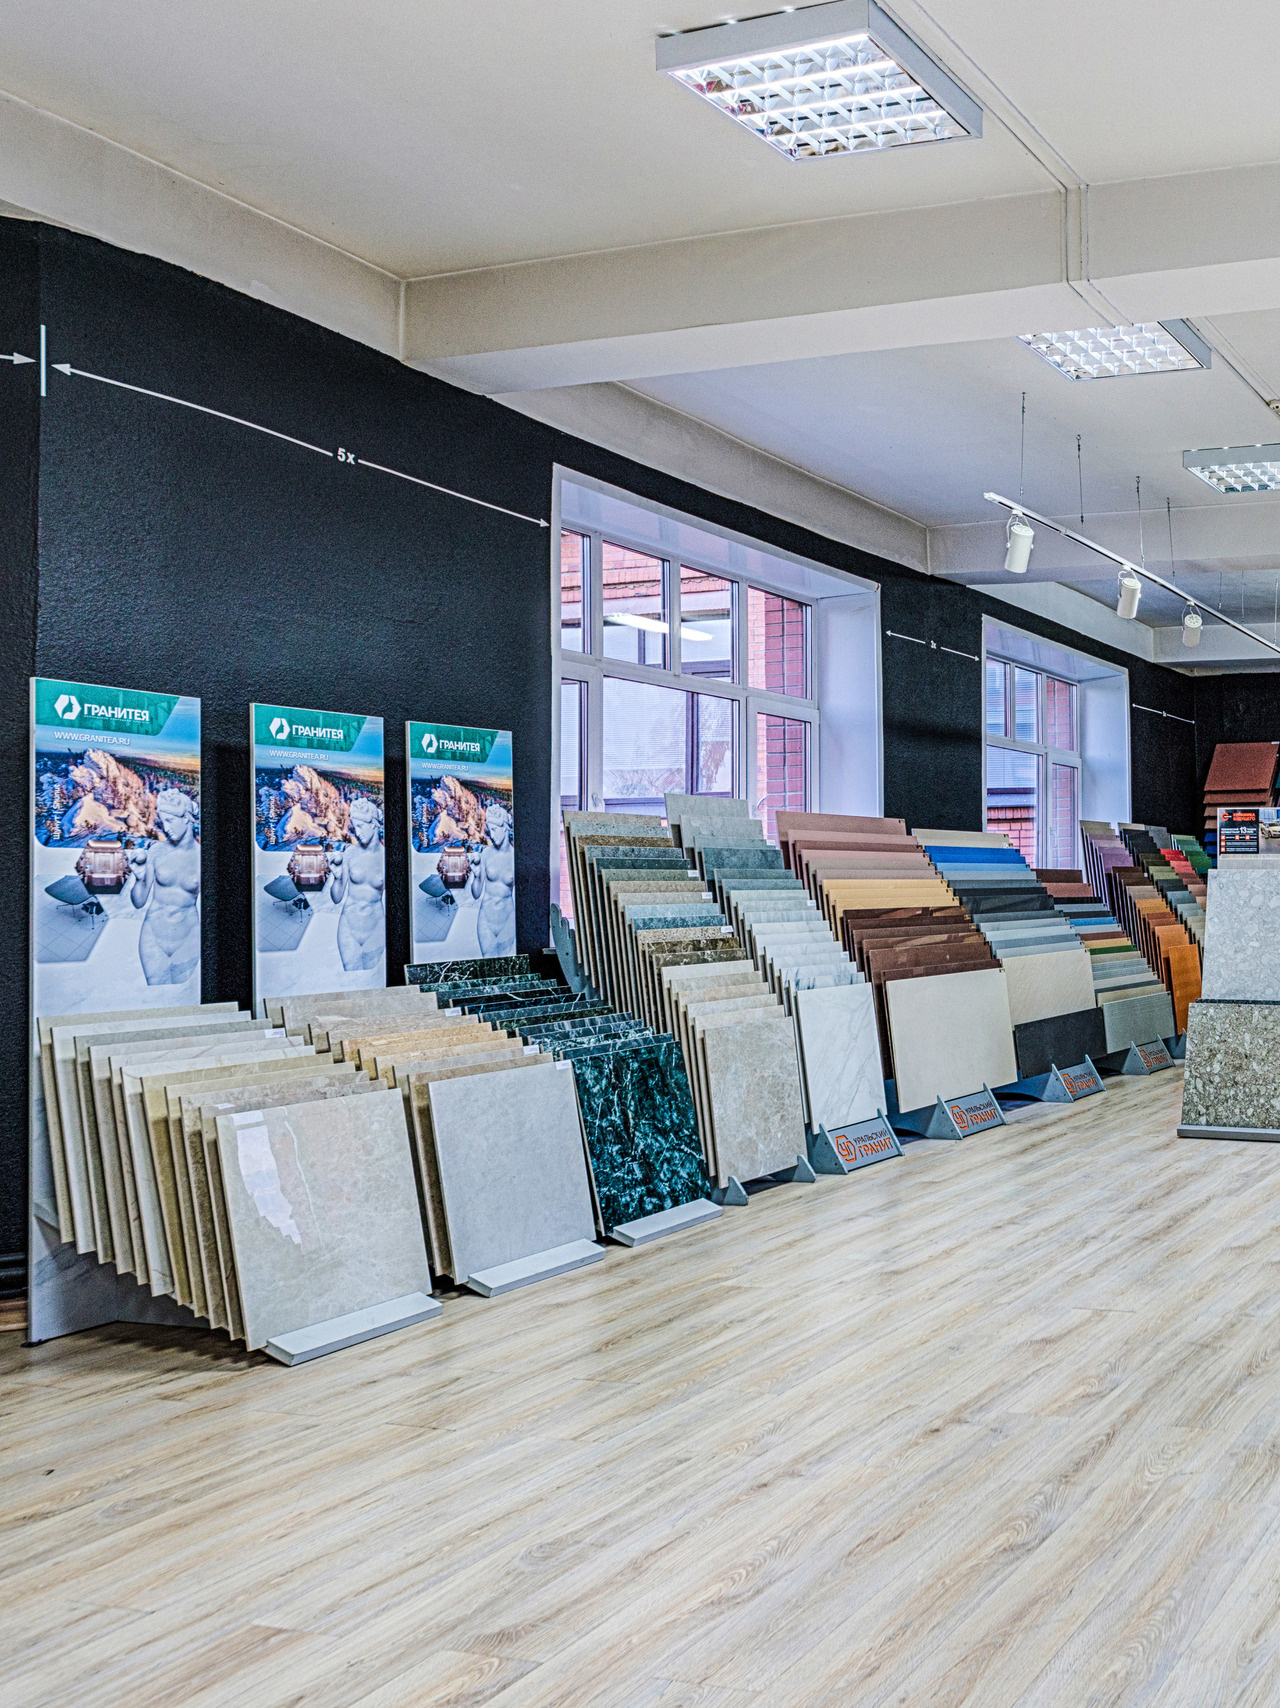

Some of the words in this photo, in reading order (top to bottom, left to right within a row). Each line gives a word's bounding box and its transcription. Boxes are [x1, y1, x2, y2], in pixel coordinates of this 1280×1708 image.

[337, 447, 355, 465] 5x
[83, 703, 150, 721] ГРАНИТЕЯ
[54, 731, 130, 745] WWW.GRANITEA.RU
[292, 725, 343, 739] ГРАНИТЕЯ
[440, 740, 480, 751] ГРАНИТЕЯ
[269, 750, 328, 760] WWW.GRANITEA.RU
[1240, 826, 1247, 834] 13
[969, 1108, 998, 1126] ГРАНИТ
[853, 1128, 888, 1145] УРАЛЬСКИЙ
[858, 1137, 893, 1157] ГРАНИТ
